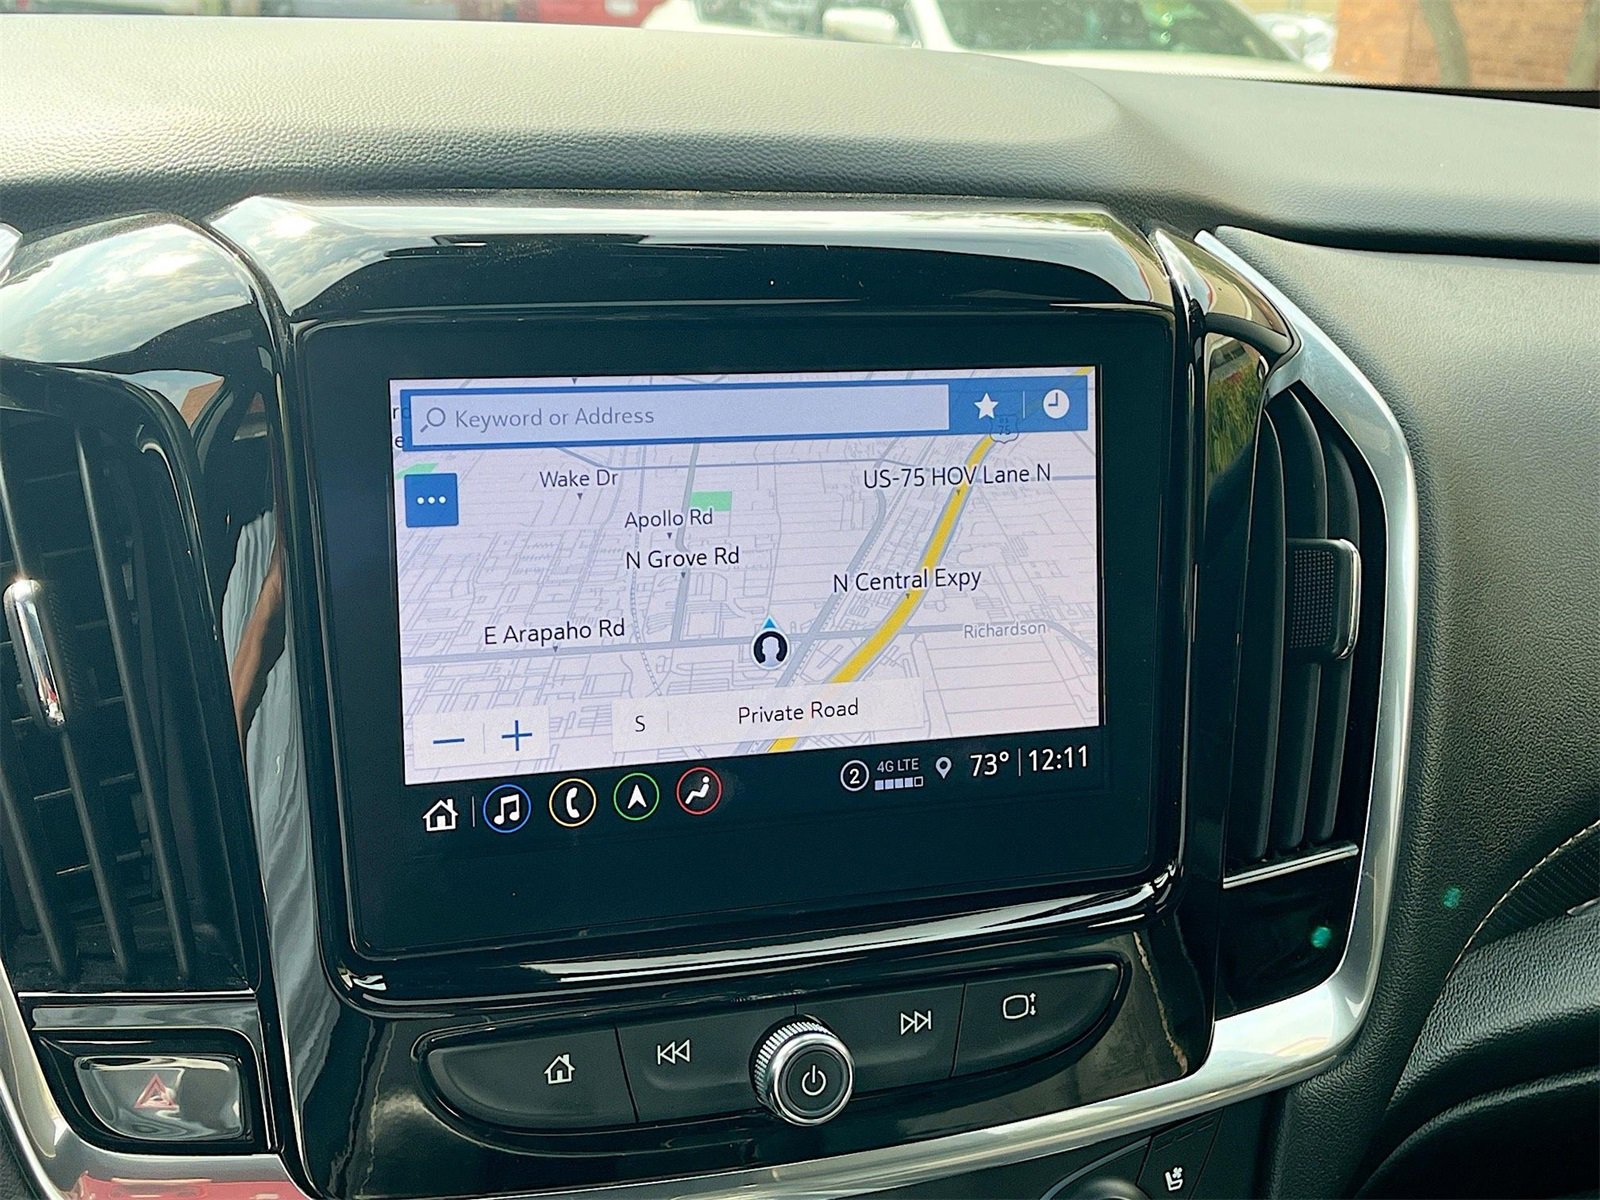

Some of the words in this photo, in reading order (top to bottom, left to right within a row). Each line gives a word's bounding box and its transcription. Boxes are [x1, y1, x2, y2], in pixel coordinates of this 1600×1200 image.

[455, 408, 542, 434] Keyword
[549, 412, 568, 426] or
[575, 407, 655, 425] Address
[539, 469, 590, 488] Wake
[596, 469, 619, 486] Dr
[863, 468, 925, 489] US-75
[932, 465, 977, 487] HOV
[983, 464, 1029, 484] Lane
[1037, 463, 1051, 482] N
[624, 510, 684, 532] Apollo
[689, 508, 713, 526] Rd
[626, 551, 640, 569] N
[647, 550, 707, 568] Grove
[714, 546, 739, 565] Rd
[834, 574, 848, 593] N
[855, 568, 928, 591] Central
[935, 568, 982, 592] Expy
[485, 626, 497, 645] E
[503, 621, 592, 648] Arapaho
[599, 618, 625, 638] Rd
[964, 621, 1046, 639] Richardson
[738, 703, 804, 724] Private
[811, 698, 859, 719] Road
[635, 715, 646, 733] S
[876, 760, 894, 773] 4G
[898, 758, 919, 771] LTE
[969, 751, 1009, 777] 73°
[1028, 745, 1088, 772] 12:11
[849, 768, 860, 784] 2
